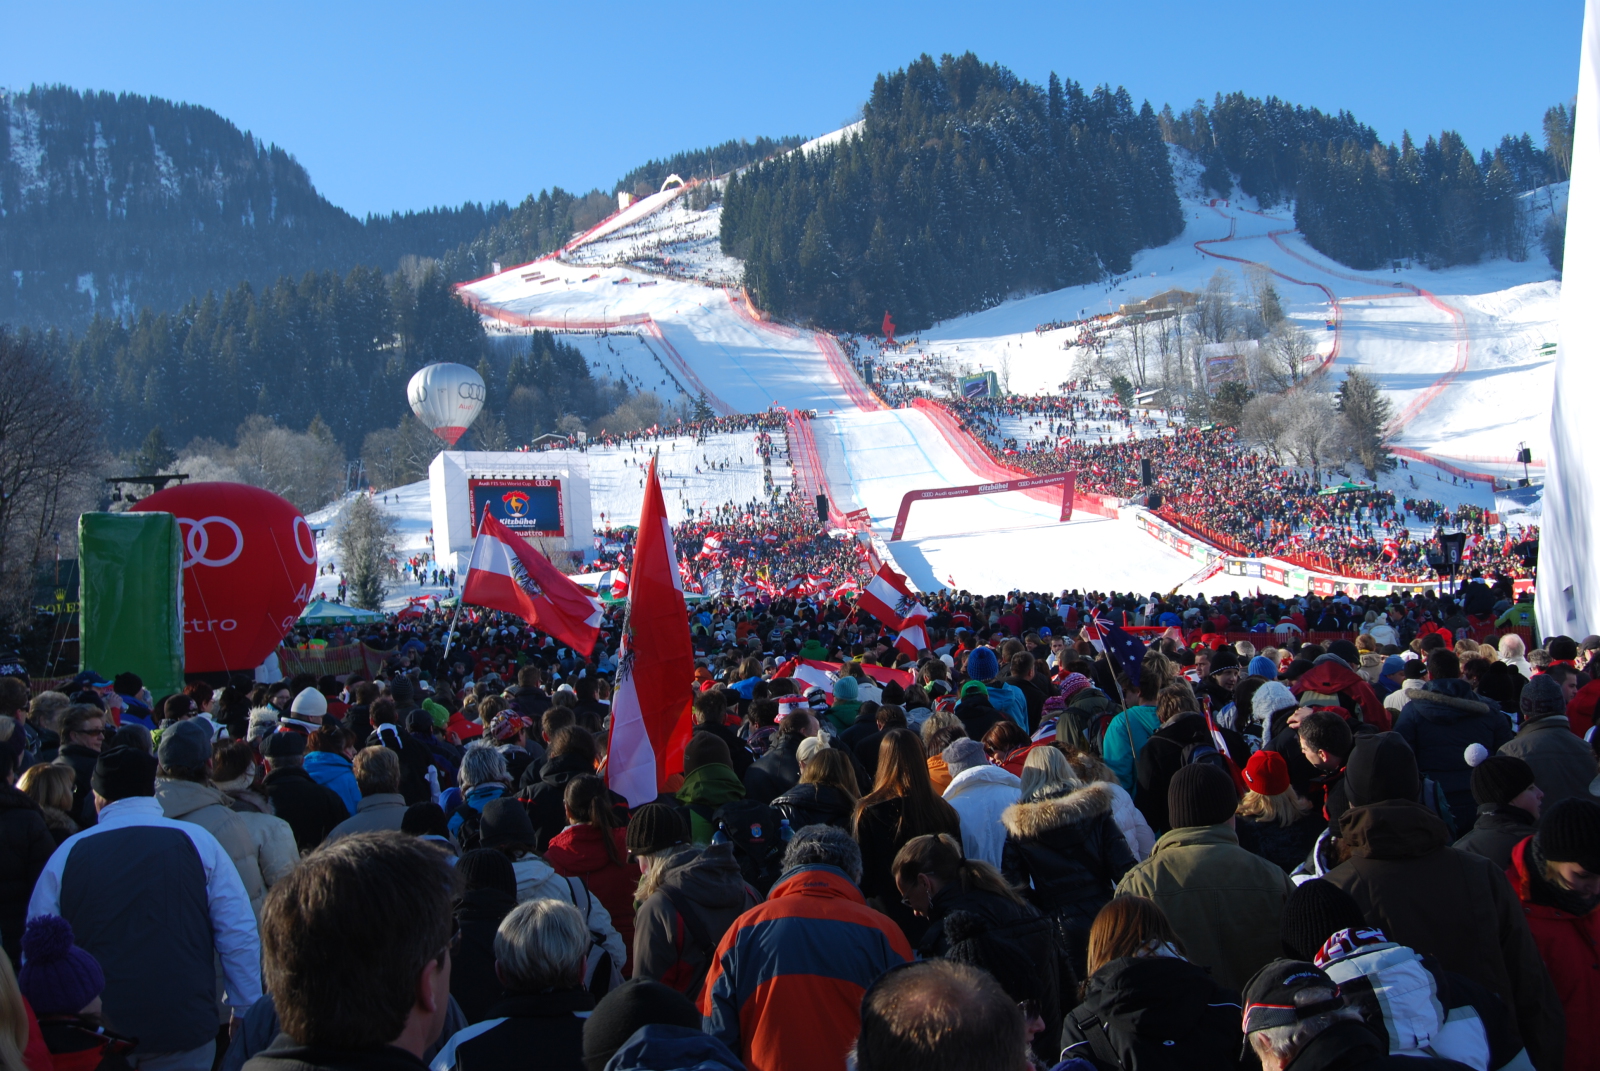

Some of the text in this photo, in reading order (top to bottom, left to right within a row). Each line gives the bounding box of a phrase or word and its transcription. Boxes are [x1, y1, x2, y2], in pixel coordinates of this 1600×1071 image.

[458, 403, 474, 411] Audi
[1044, 475, 1065, 484] quattro
[1450, 549, 1457, 563] 9
[183, 618, 238, 633] ttro
